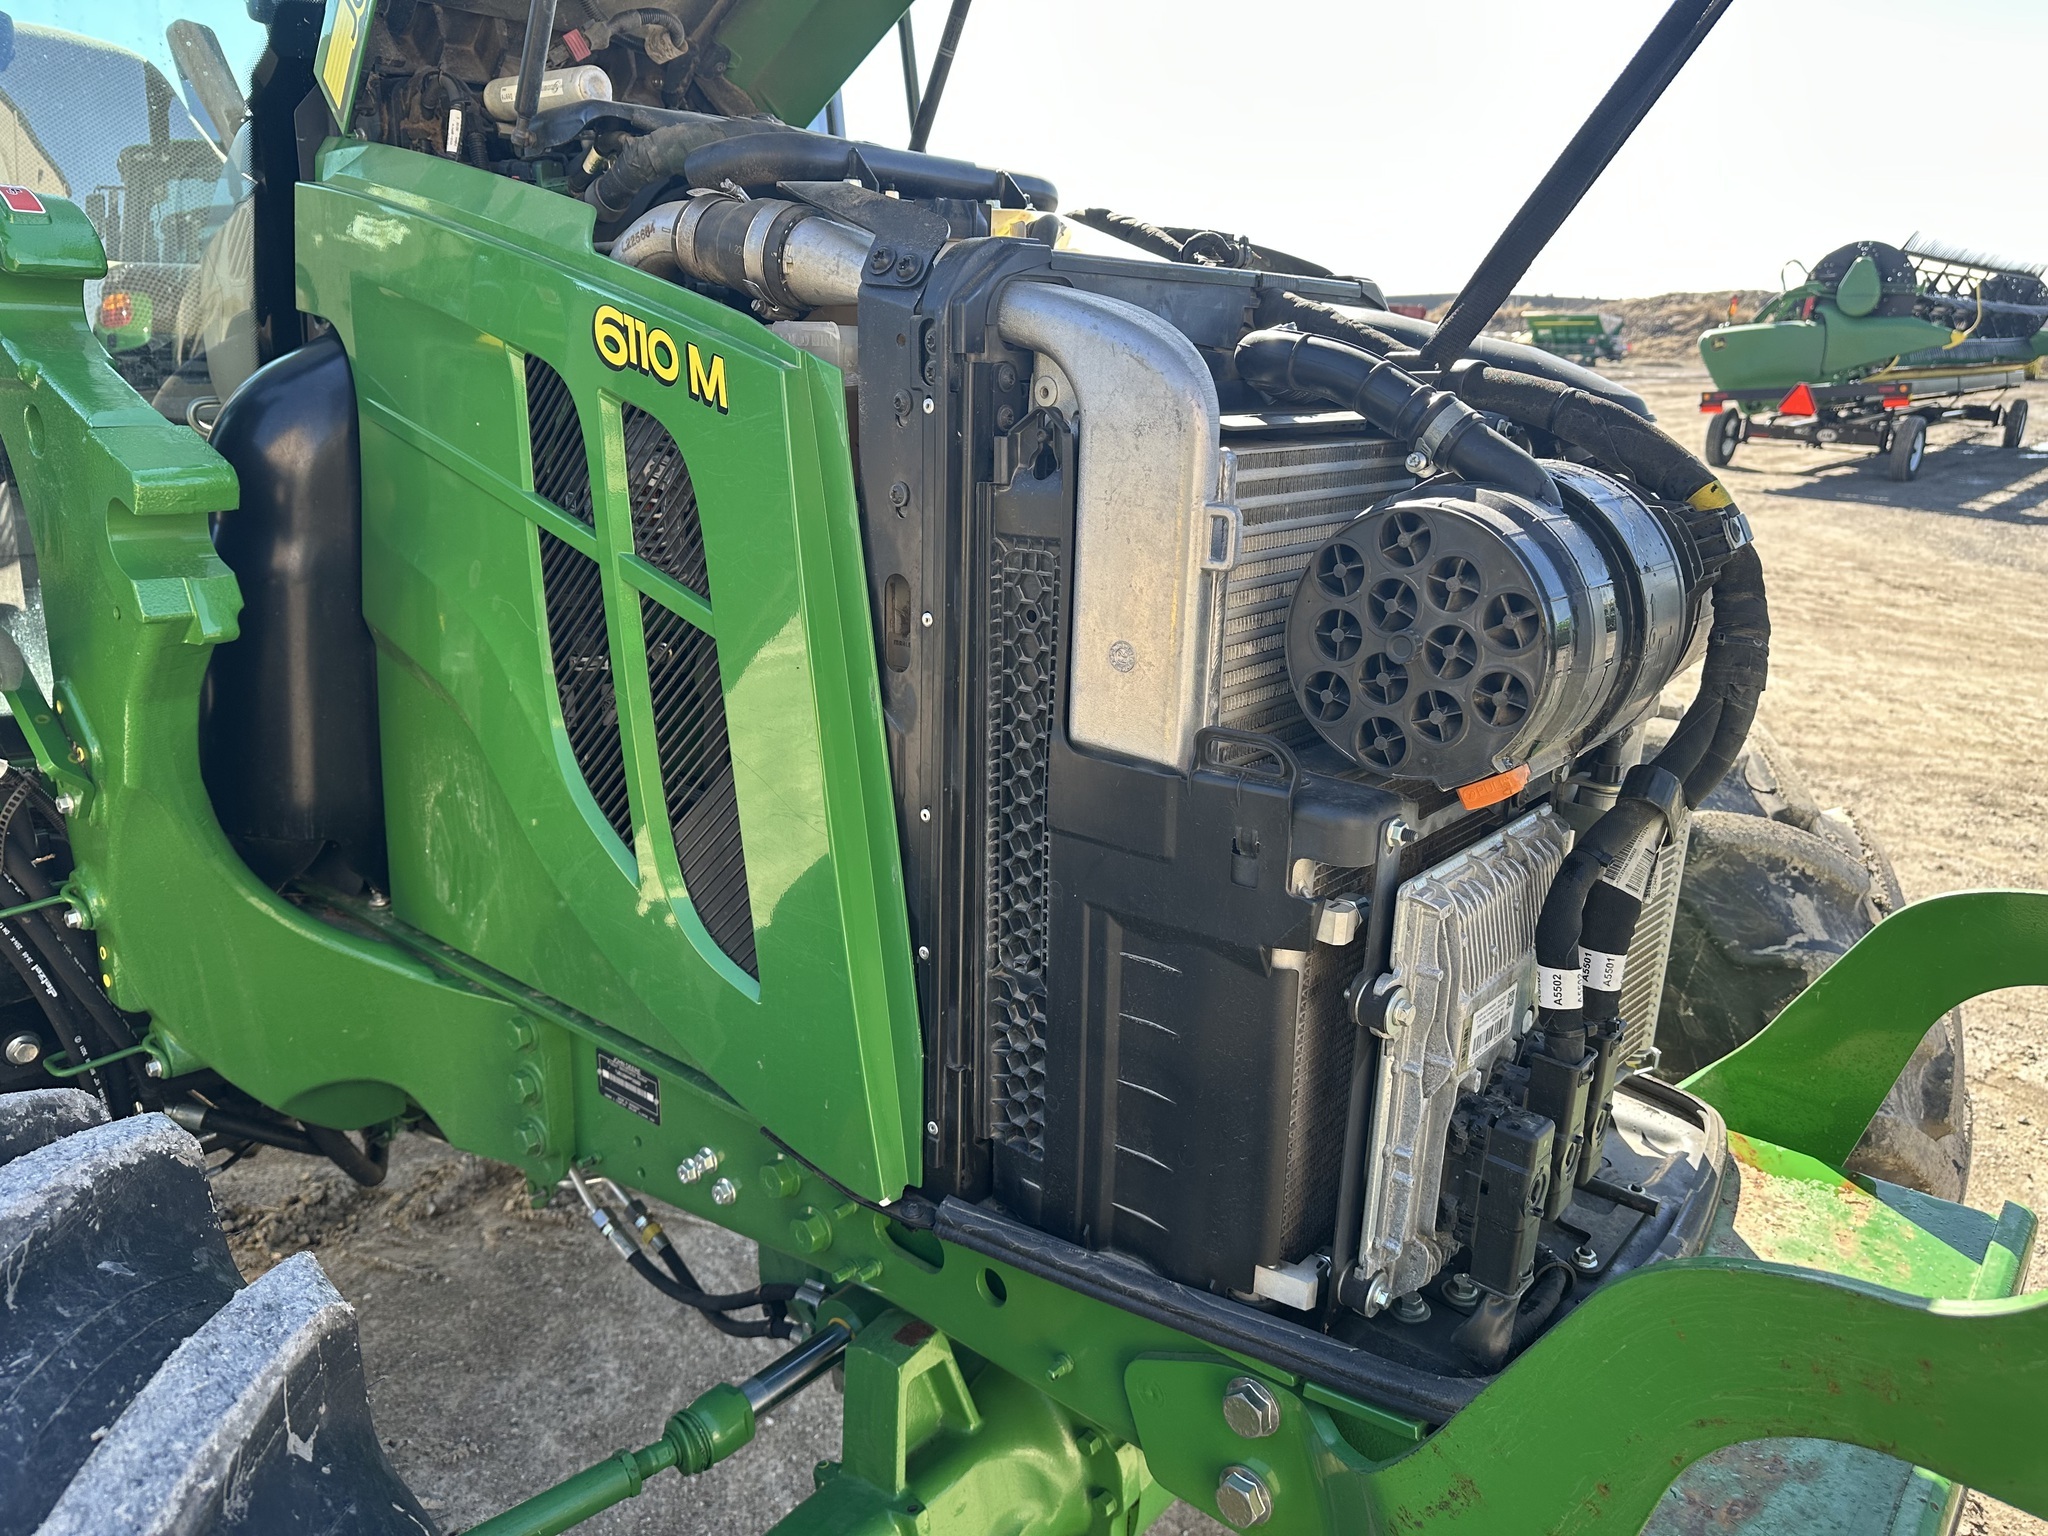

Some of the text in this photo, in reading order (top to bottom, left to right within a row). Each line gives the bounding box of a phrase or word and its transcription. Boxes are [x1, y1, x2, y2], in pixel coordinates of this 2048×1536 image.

[593, 304, 728, 415] 6110 M
[1582, 952, 1592, 982] A5501
[1603, 957, 1615, 987] A5501
[1552, 974, 1563, 1006] A5502
